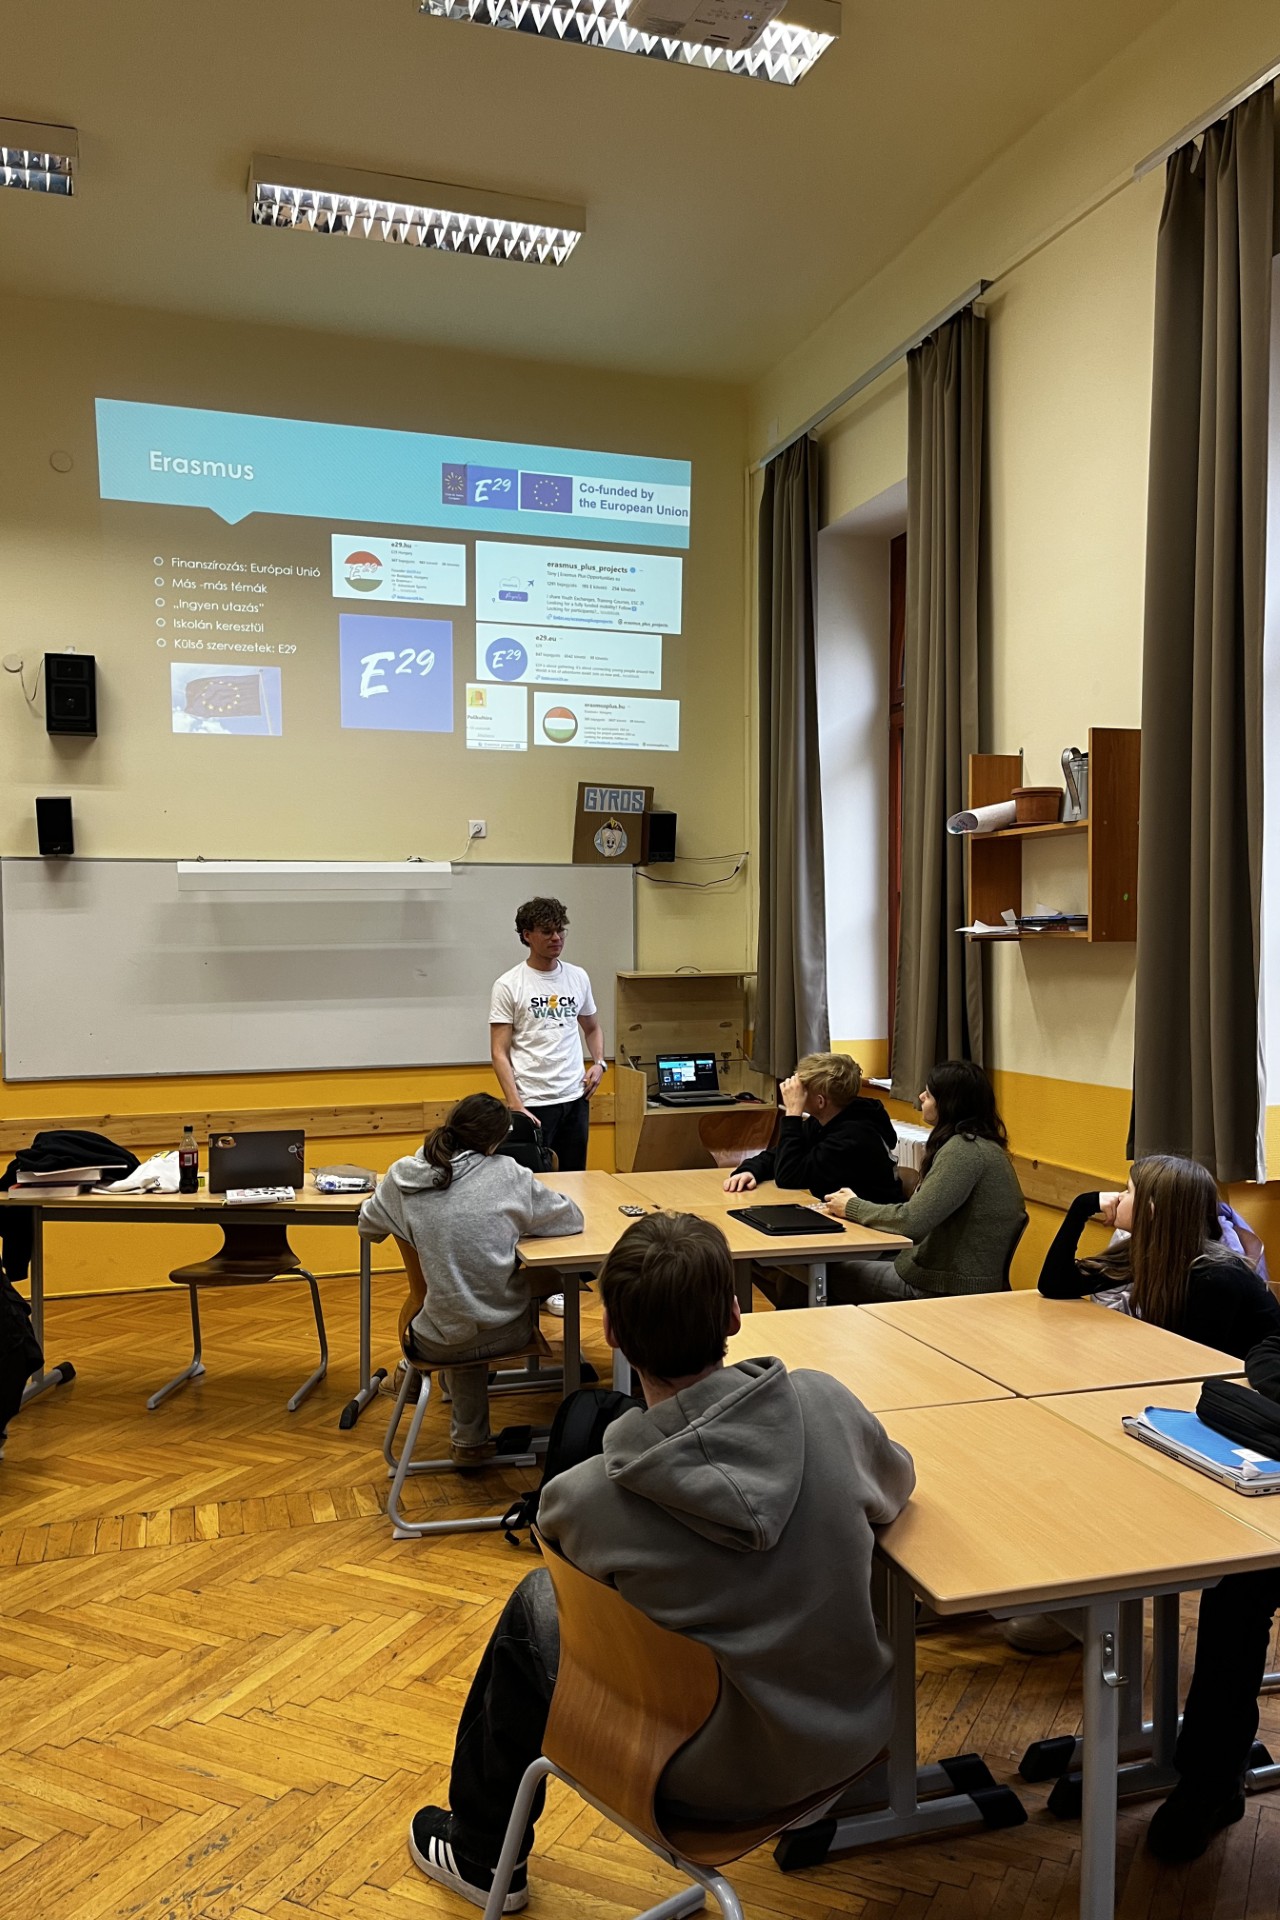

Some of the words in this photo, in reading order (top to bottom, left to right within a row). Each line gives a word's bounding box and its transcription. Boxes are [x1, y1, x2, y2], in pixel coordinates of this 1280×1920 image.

[149, 450, 254, 480] Erasmus
[474, 478, 512, 502] E29
[579, 482, 638, 498] Co-funded
[641, 488, 654, 501] by
[579, 498, 596, 509] the
[600, 499, 653, 514] European
[656, 504, 689, 517] Union
[171, 557, 247, 573] Finanszírozás:
[250, 563, 293, 576] Európai
[297, 566, 321, 577] Unió
[547, 562, 628, 573] erasmus_plus_projects
[172, 578, 197, 590] Más
[200, 580, 228, 591] -más
[231, 582, 268, 594] témák
[173, 618, 213, 630] Iskolán
[216, 620, 264, 633] keresztül
[174, 638, 204, 650] Külső
[206, 641, 275, 653] szervezetek:
[278, 644, 297, 654] E29
[535, 634, 557, 642] e29.eu
[492, 649, 522, 669] E29
[359, 648, 435, 698] E29
[585, 788, 644, 812] GYROS
[532, 1007, 577, 1018] WAVES
